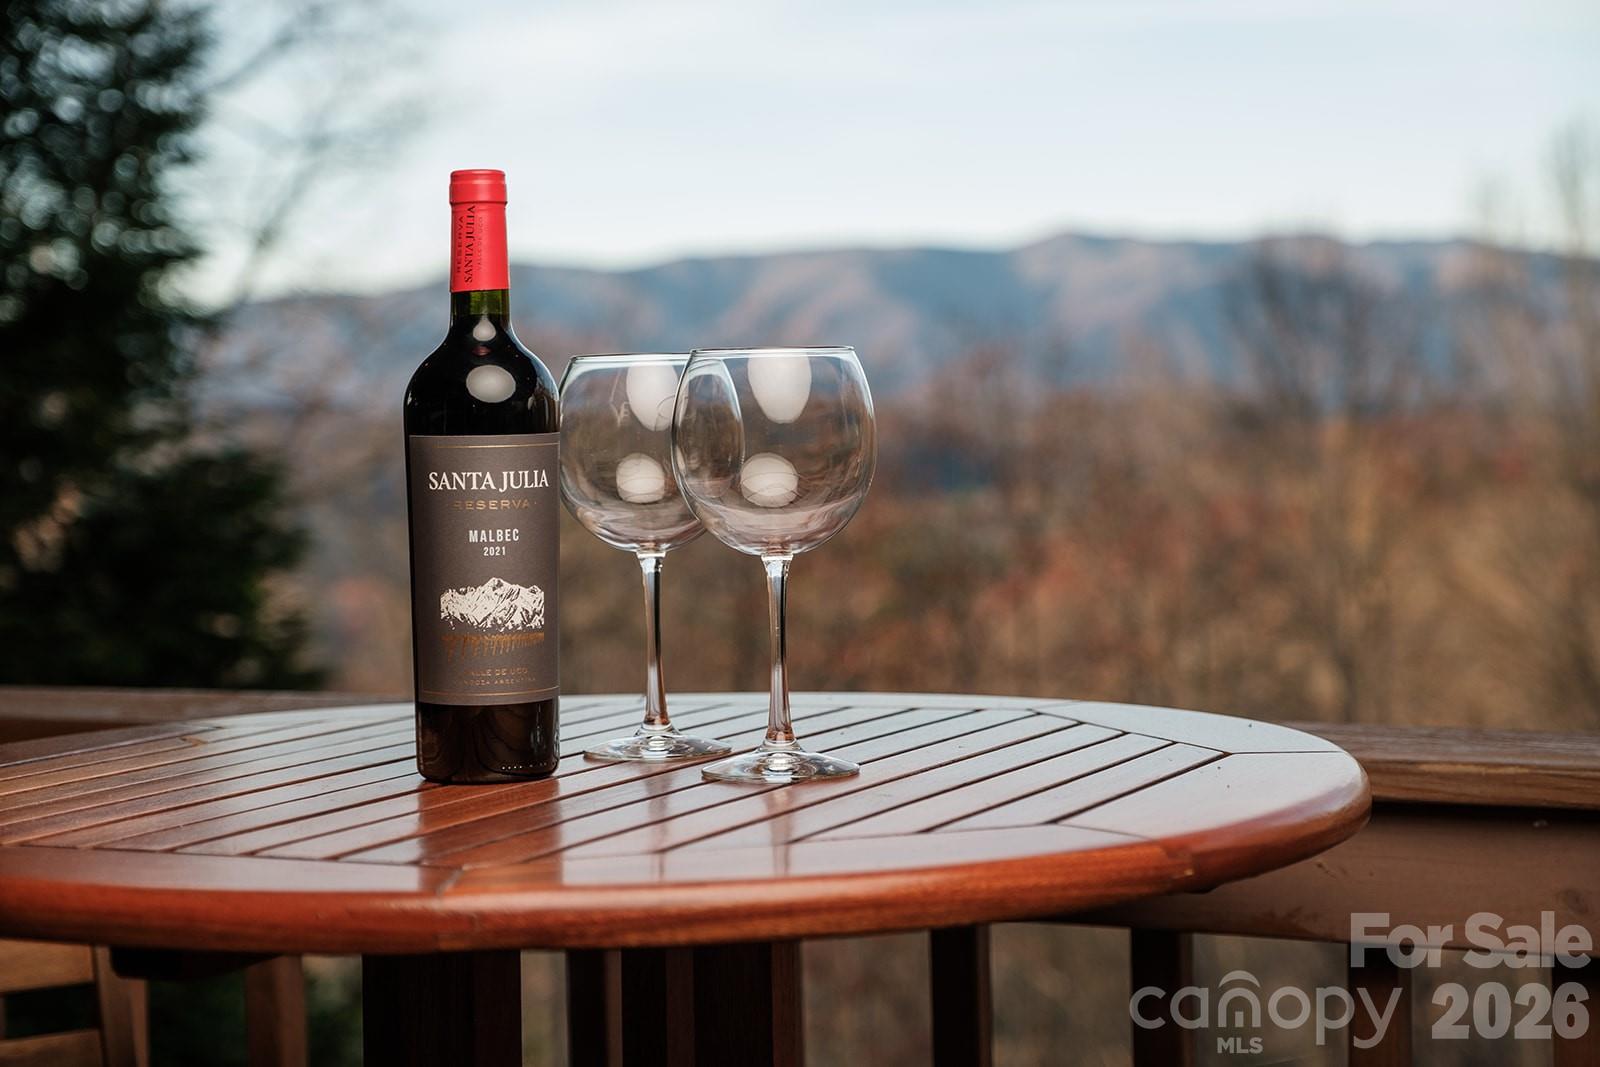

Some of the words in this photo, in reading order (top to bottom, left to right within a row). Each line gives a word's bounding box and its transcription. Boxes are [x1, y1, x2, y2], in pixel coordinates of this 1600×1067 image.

[465, 205, 475, 241] JULIA
[464, 243, 473, 283] SANTA
[428, 471, 497, 491] SANTA
[499, 469, 549, 492] JULIA
[452, 498, 530, 511] RESERVA
[468, 527, 520, 543] MALBEC
[483, 545, 506, 557] 2021
